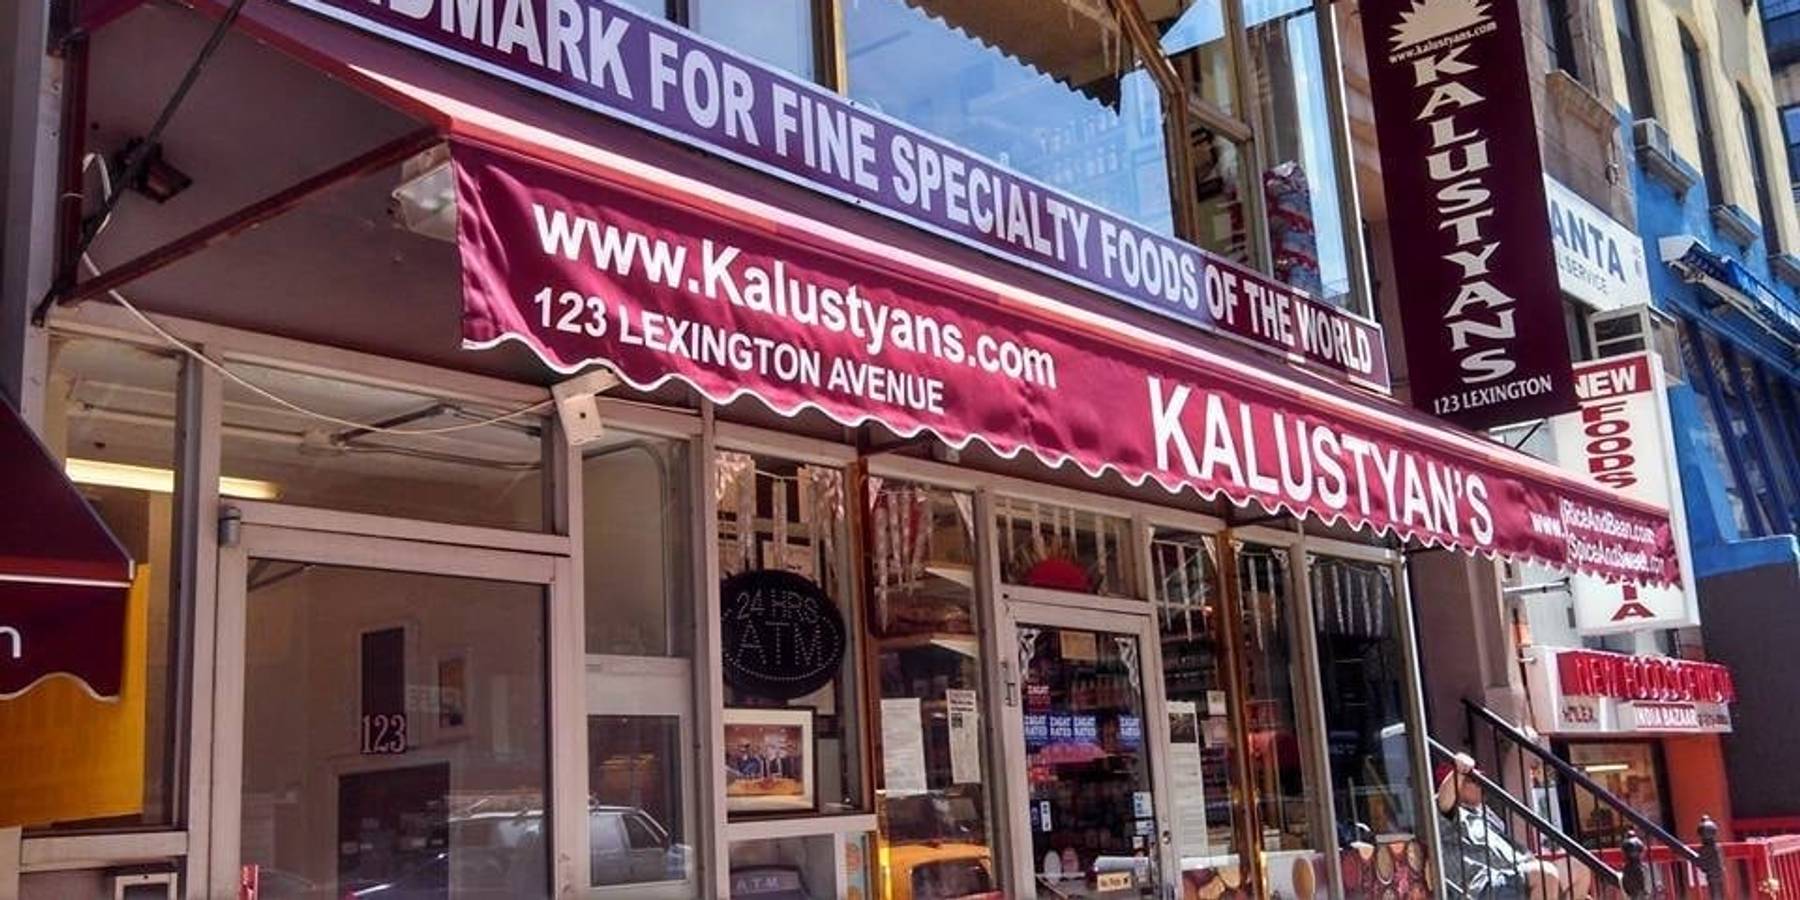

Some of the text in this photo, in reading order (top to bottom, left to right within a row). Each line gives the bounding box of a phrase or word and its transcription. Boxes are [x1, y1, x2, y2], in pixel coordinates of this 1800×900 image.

[1389, 21, 1497, 63] www.kalustyans.com
[648, 32, 758, 146] FOR
[774, 83, 879, 192] FINE
[892, 135, 1090, 270] SPECIALTY
[1102, 223, 1198, 310] FOODS
[1205, 264, 1241, 323] OF
[1243, 280, 1296, 347] THE
[1297, 294, 1371, 374] WORLD
[1413, 44, 1516, 384] KALUSTYANS
[532, 203, 1056, 388] www.Kalustyans.com
[535, 287, 944, 415] 123 LEXINGTON AVENUE
[1575, 366, 1635, 398] NEW
[1434, 375, 1552, 415] 123 LEXINGTON
[1147, 376, 1494, 546] KALUSTYAN'S
[1580, 401, 1637, 489] FOODS
[737, 588, 820, 624] 24 HRS
[736, 619, 821, 667] ATM
[363, 714, 406, 753] 123
